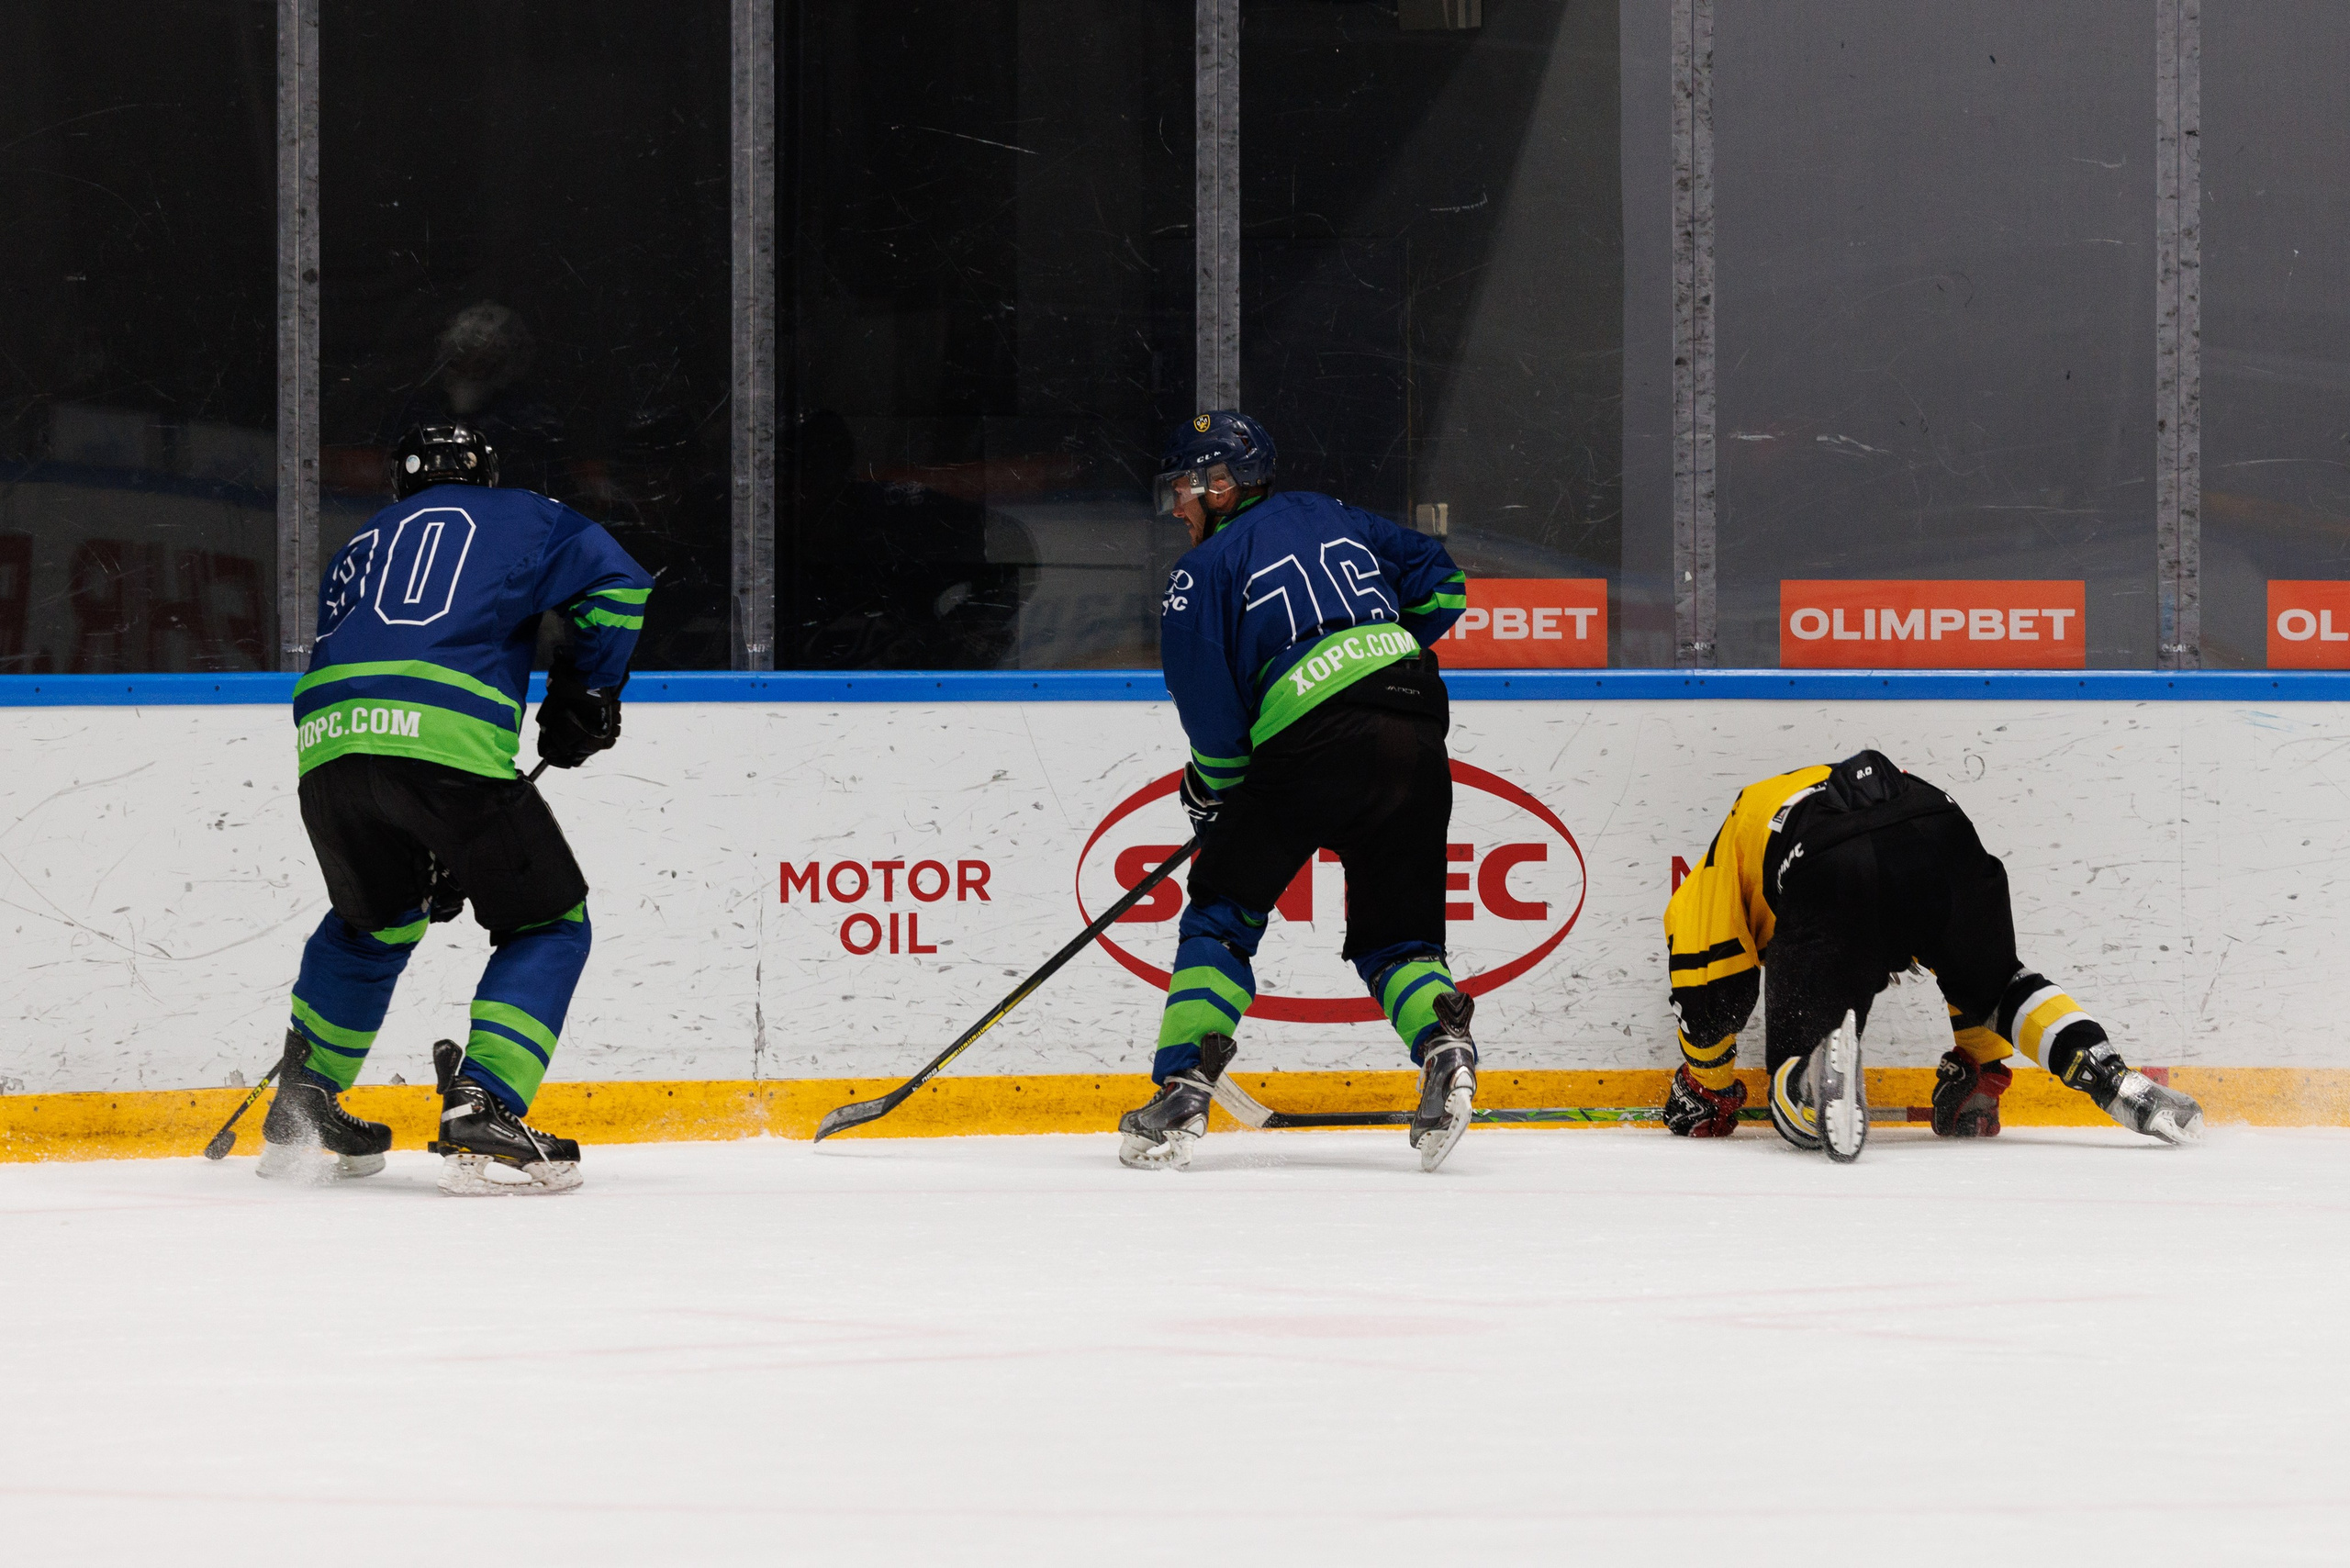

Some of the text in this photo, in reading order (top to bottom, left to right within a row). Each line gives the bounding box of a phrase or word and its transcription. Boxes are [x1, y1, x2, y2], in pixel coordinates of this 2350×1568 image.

[1243, 537, 1400, 650] 76
[1438, 607, 1598, 640] PBET
[1789, 608, 2076, 640] OLIMPBET
[2277, 609, 2349, 642] OL
[1288, 632, 1417, 697] XOPC.COM
[779, 859, 992, 903] MOTOR
[839, 912, 938, 956] OIL
